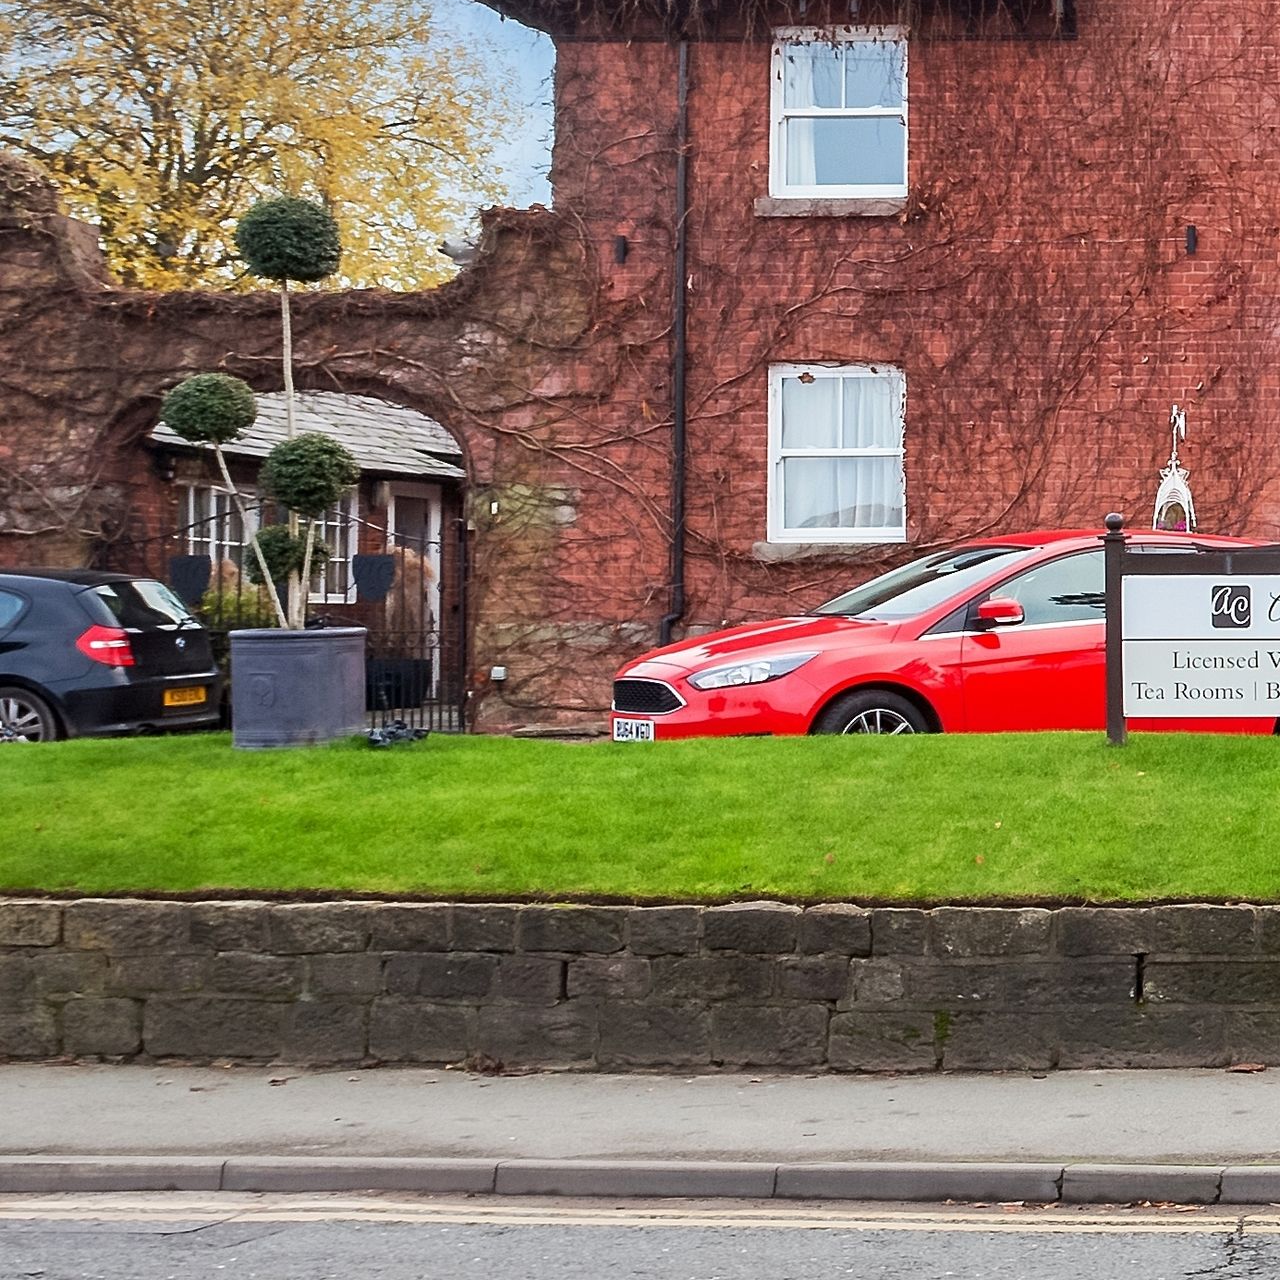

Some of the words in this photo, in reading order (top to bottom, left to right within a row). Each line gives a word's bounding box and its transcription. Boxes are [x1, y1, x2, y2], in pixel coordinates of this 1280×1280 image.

[1172, 650, 1259, 669] Licensed
[1131, 681, 1165, 700] Tea
[1174, 681, 1244, 700] Rooms
